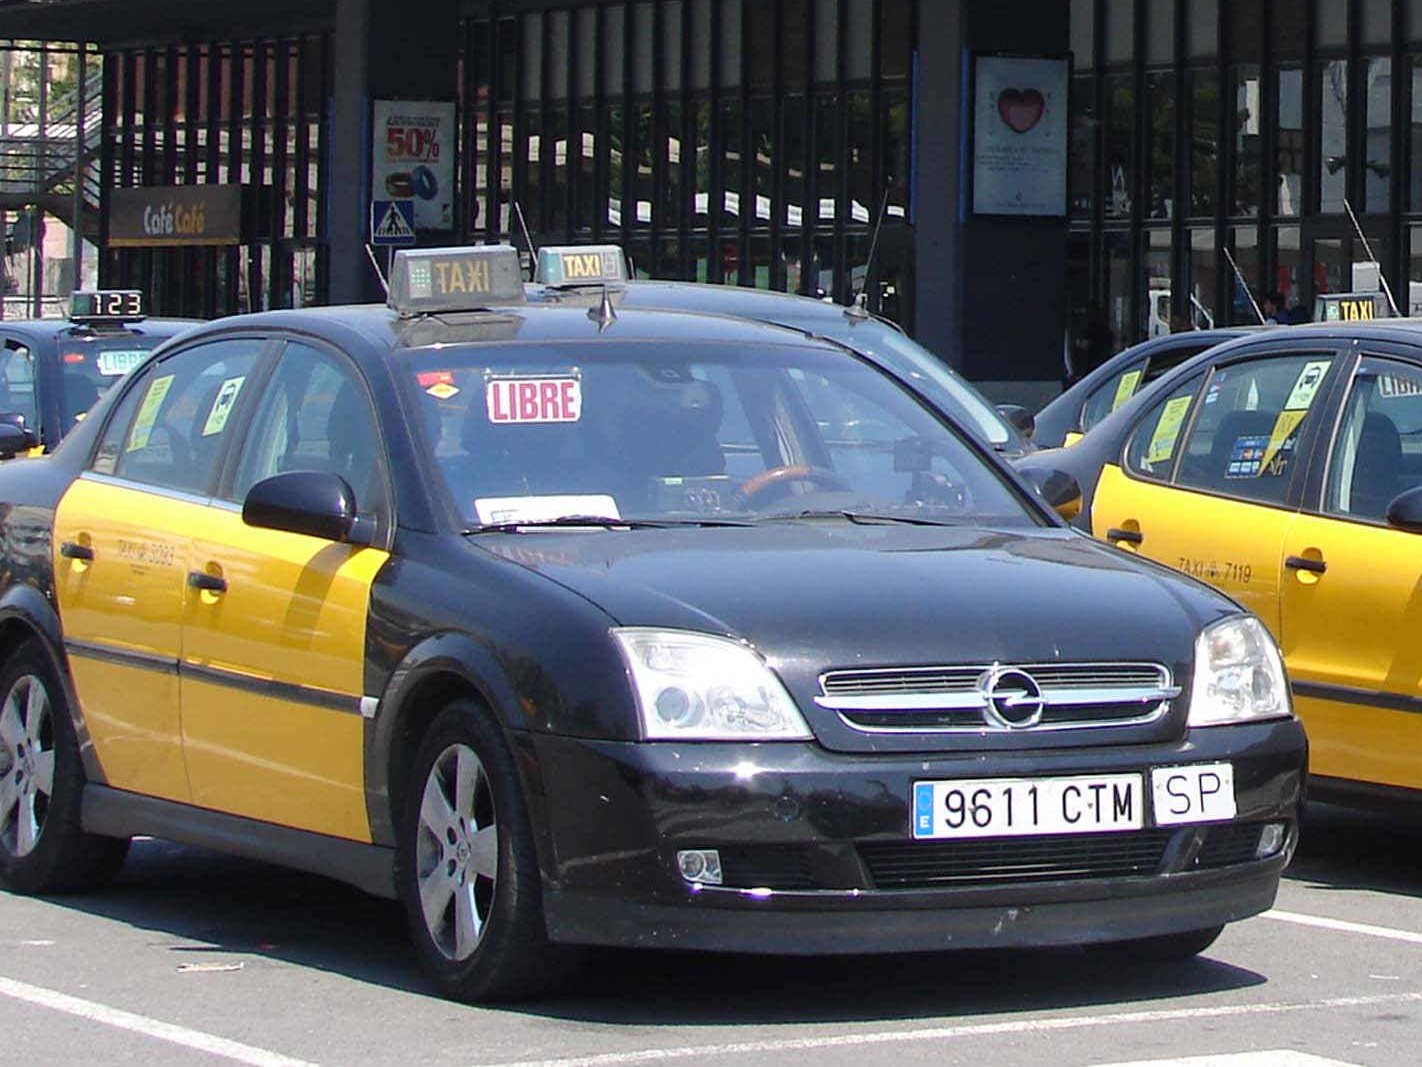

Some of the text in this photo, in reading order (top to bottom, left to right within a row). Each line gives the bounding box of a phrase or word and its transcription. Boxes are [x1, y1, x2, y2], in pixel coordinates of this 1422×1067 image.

[386, 127, 440, 158] 50%
[436, 260, 490, 294] TAXI
[563, 255, 601, 278] TAXI
[1341, 300, 1373, 321] TAXI
[492, 381, 576, 420] LIBRE
[1179, 557, 1253, 584] TAXI 7119
[919, 782, 1133, 829] E 9611 CTM
[1165, 772, 1222, 815] SP
